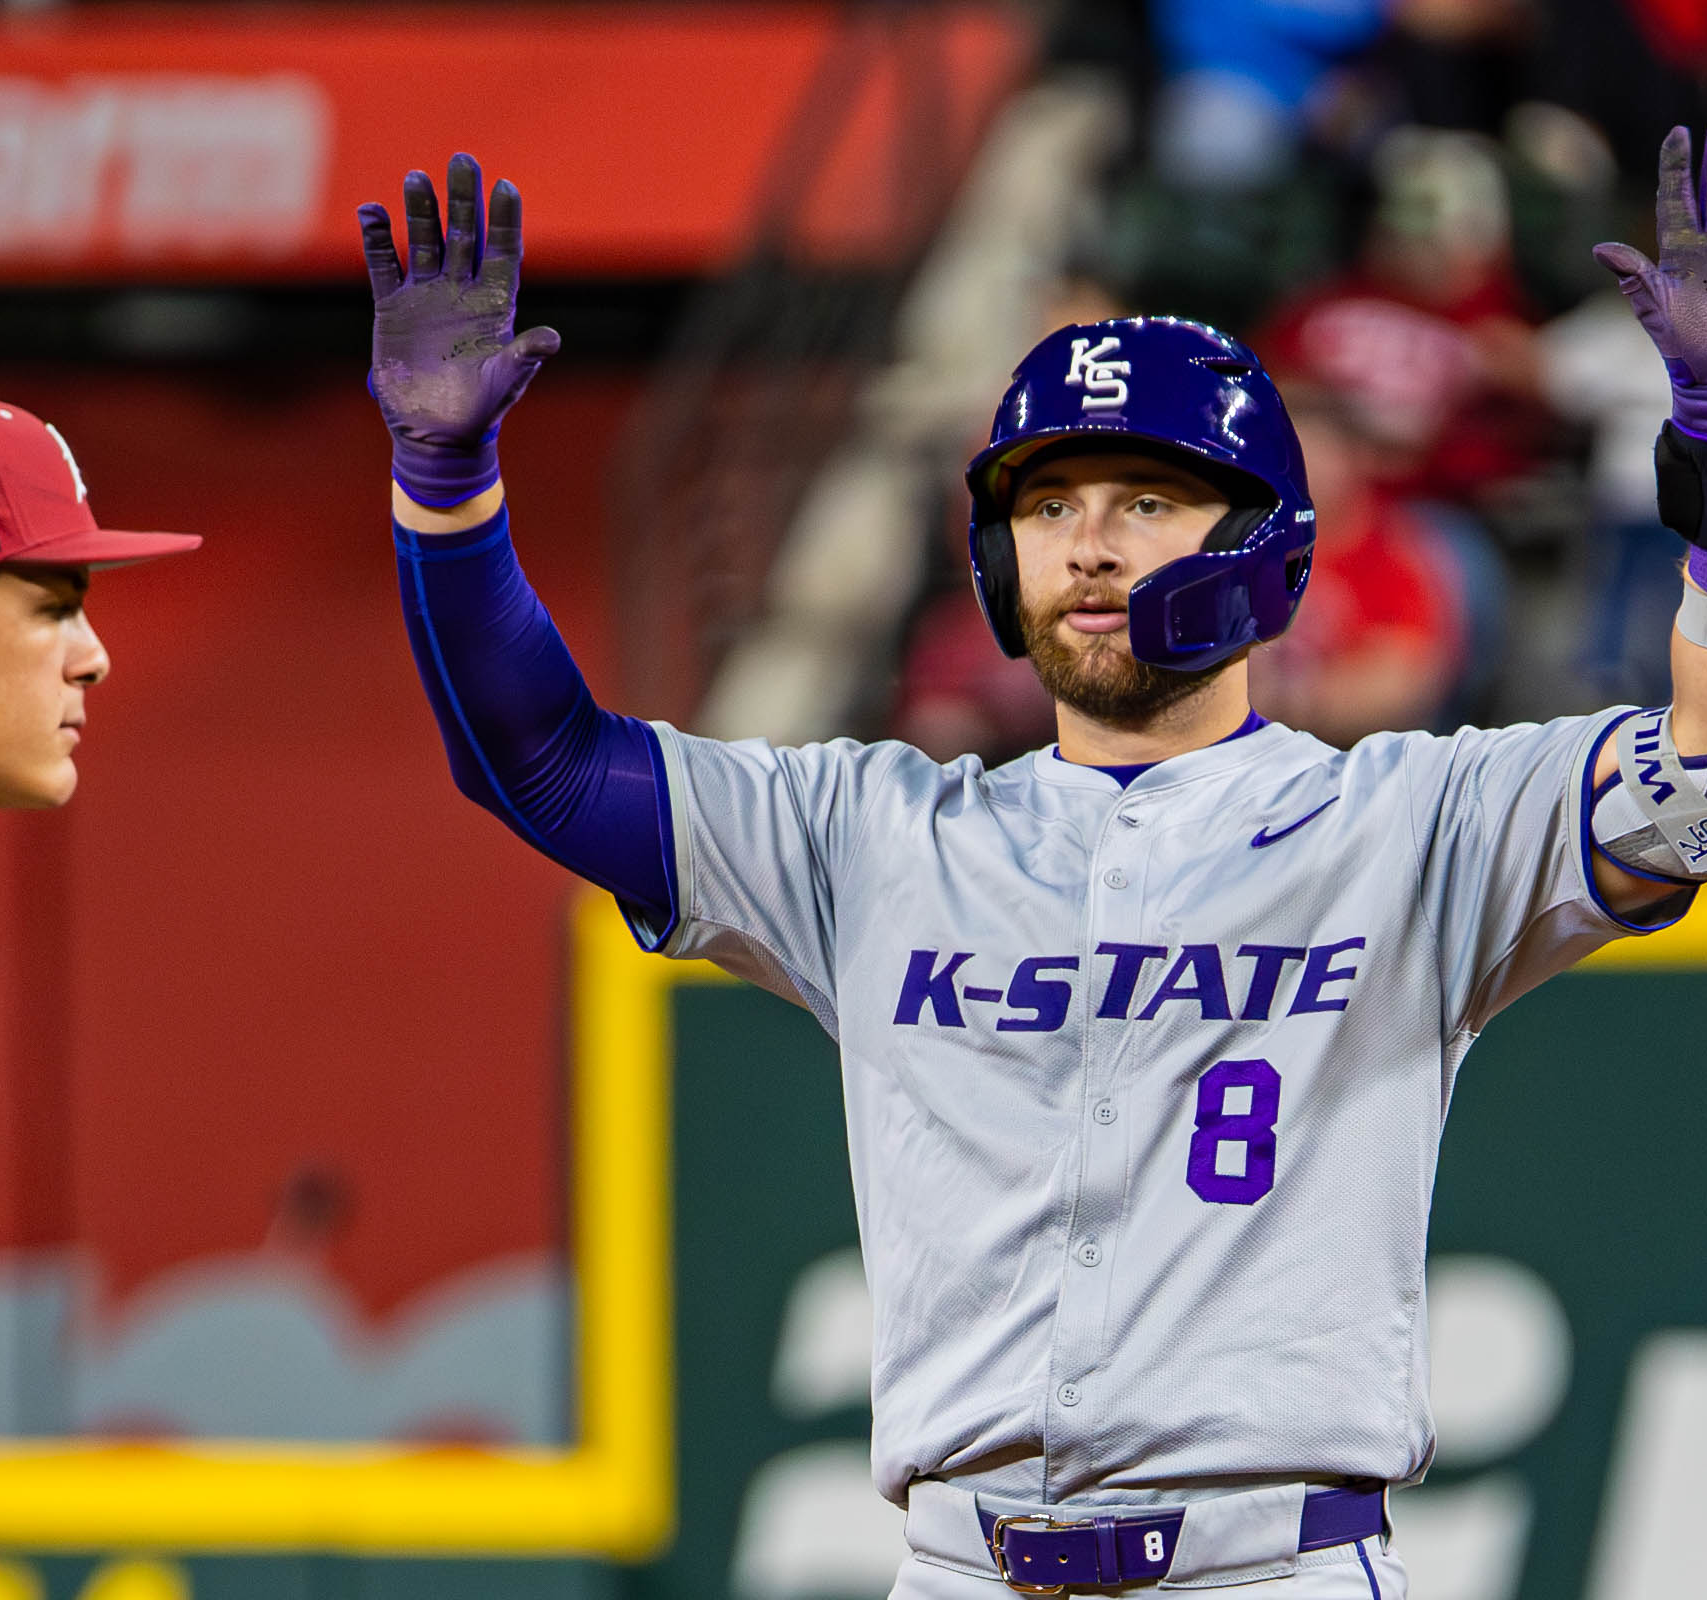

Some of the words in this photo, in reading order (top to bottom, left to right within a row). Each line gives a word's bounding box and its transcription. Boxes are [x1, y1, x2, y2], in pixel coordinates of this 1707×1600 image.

[1065, 337, 1131, 410] KS
[1634, 705, 1677, 806] WIL
[893, 937, 1366, 1032] K-STATE
[1186, 1059, 1281, 1205] 8
[1144, 1531, 1164, 1561] 8
